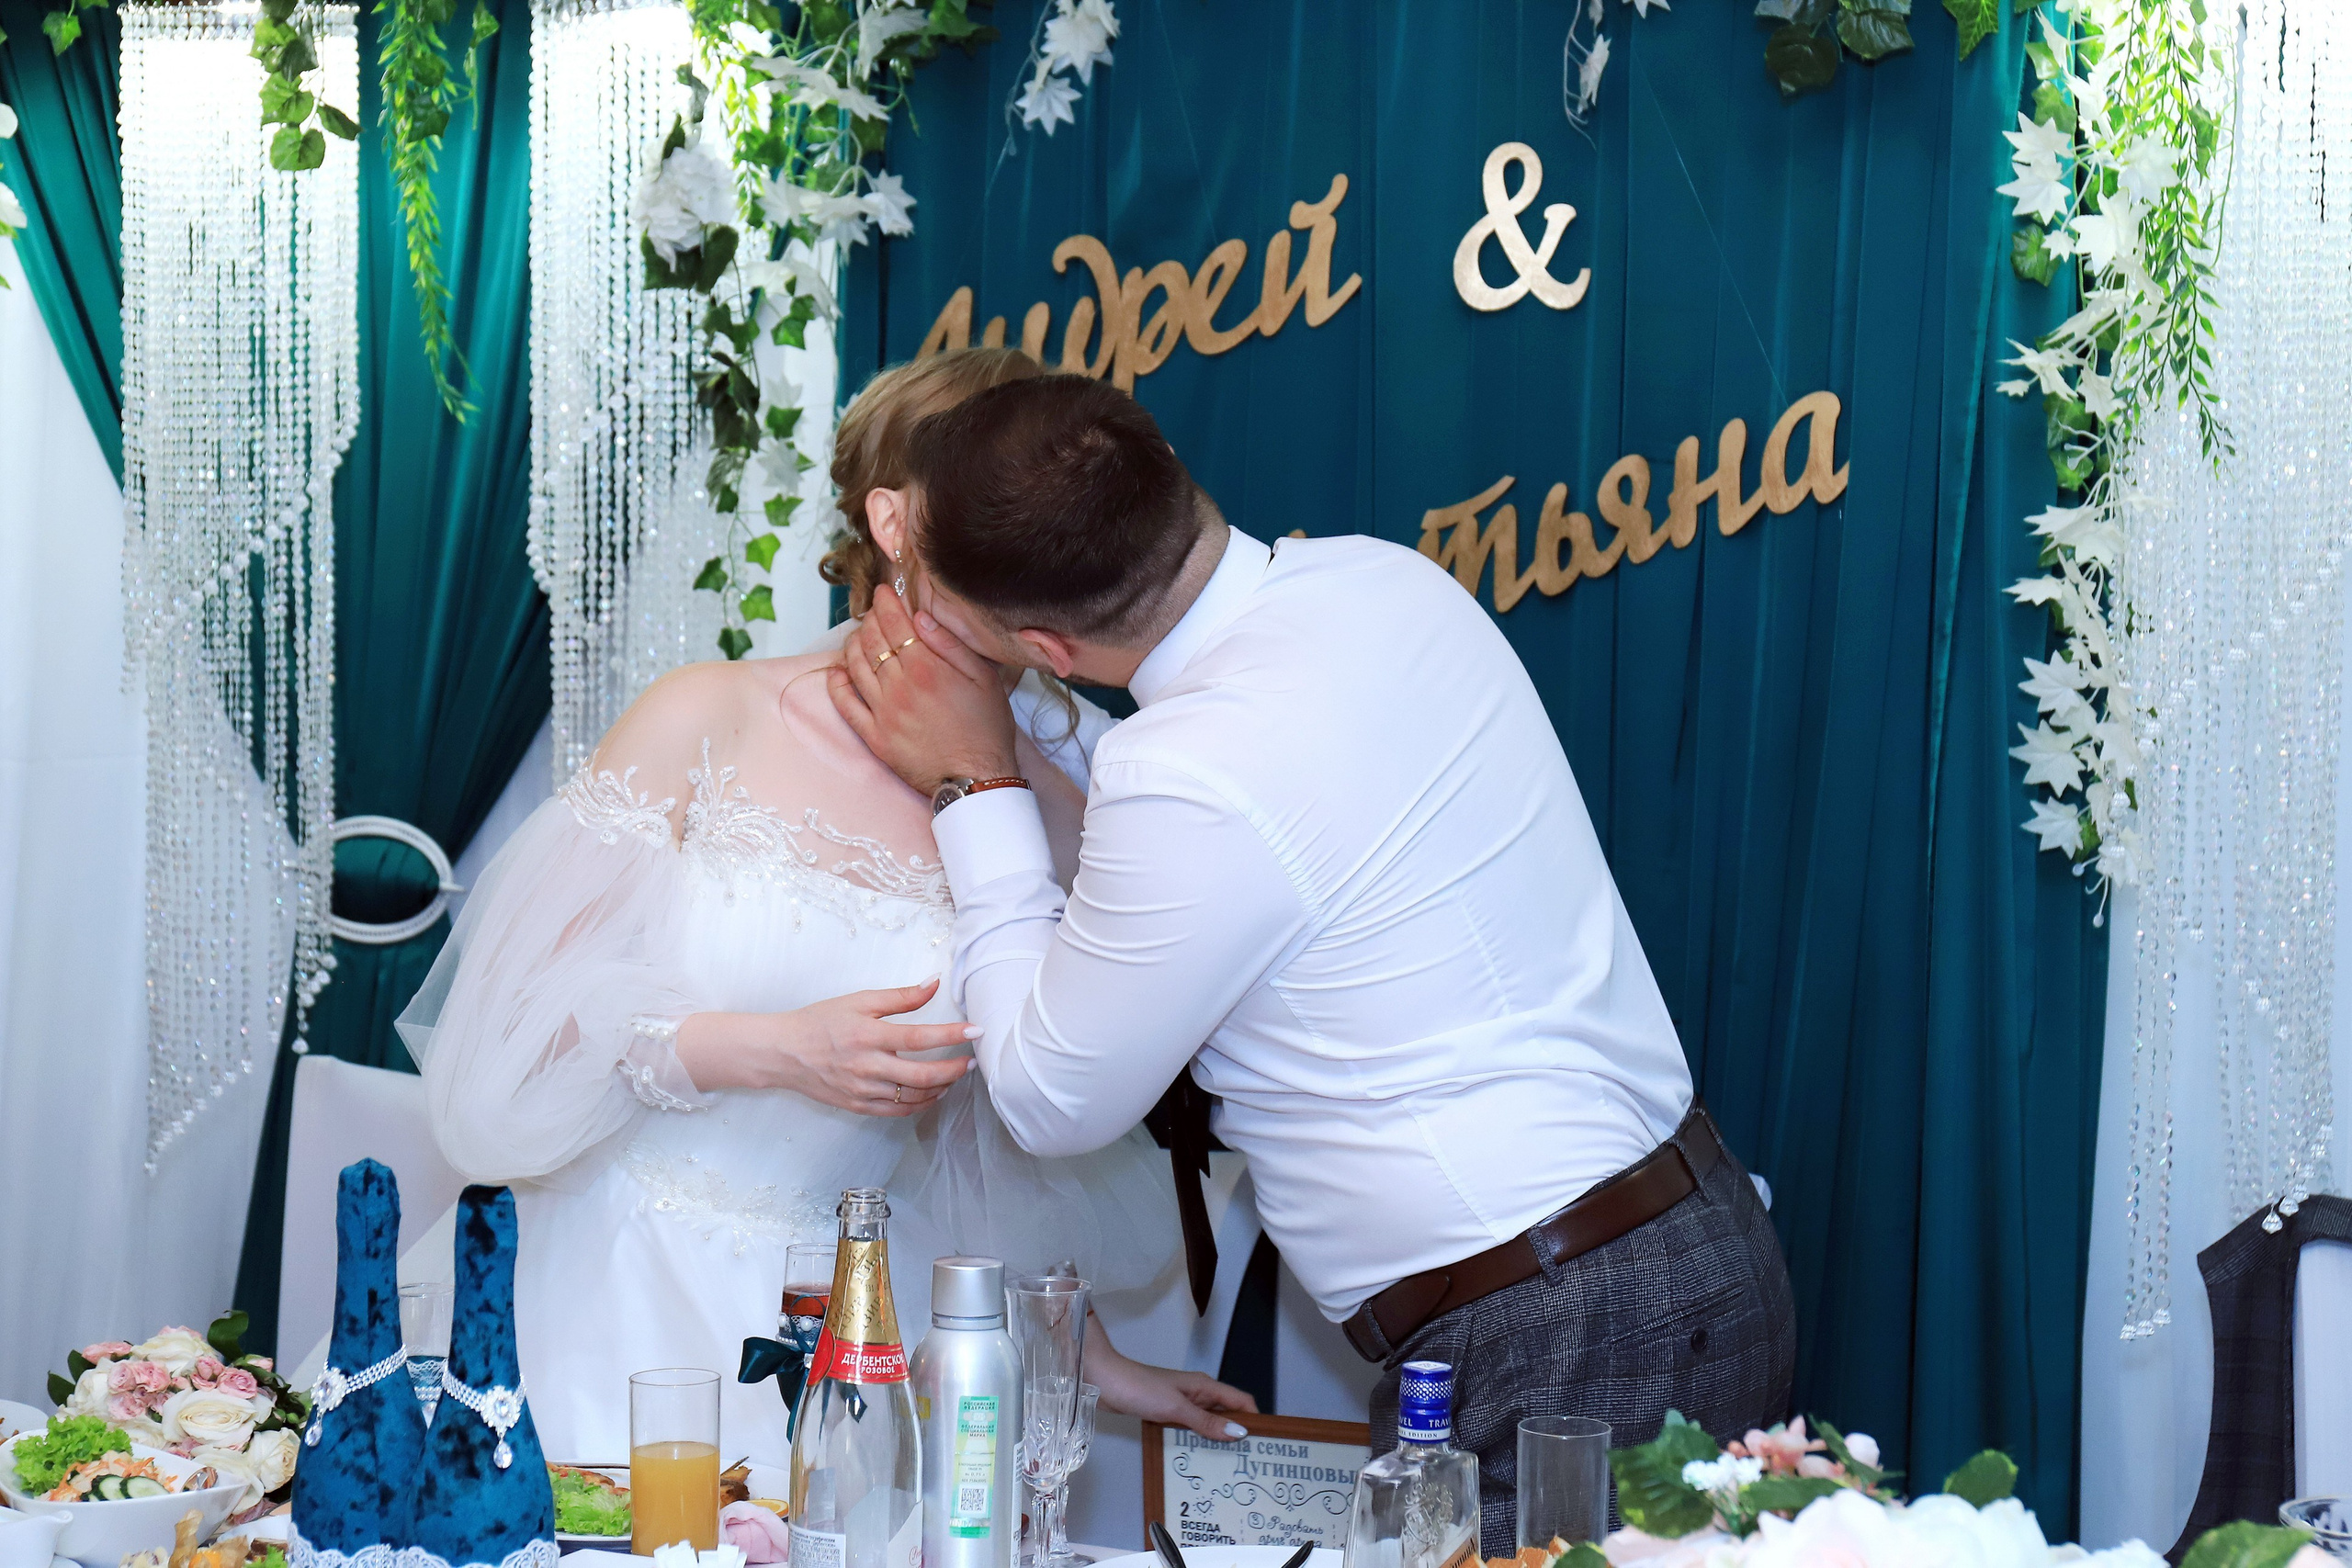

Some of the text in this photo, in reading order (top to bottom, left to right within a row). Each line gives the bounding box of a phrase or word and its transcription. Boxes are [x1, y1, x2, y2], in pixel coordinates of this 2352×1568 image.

[1453, 141, 1591, 312] &
[1416, 389, 1850, 614] тьяна
[841, 1352, 905, 1367] ДЕРБЕНТСКОЕ
[1257, 1441, 1309, 1459] семьи
[1233, 1453, 1357, 1484] Дугинцовы
[1180, 1501, 1190, 1517] 2
[1181, 1520, 1220, 1533] ВСЕГДА
[1267, 1516, 1323, 1538] Радовать
[1181, 1530, 1237, 1545] ГОВОРИТЬ
[1289, 1538, 1323, 1549] дра
